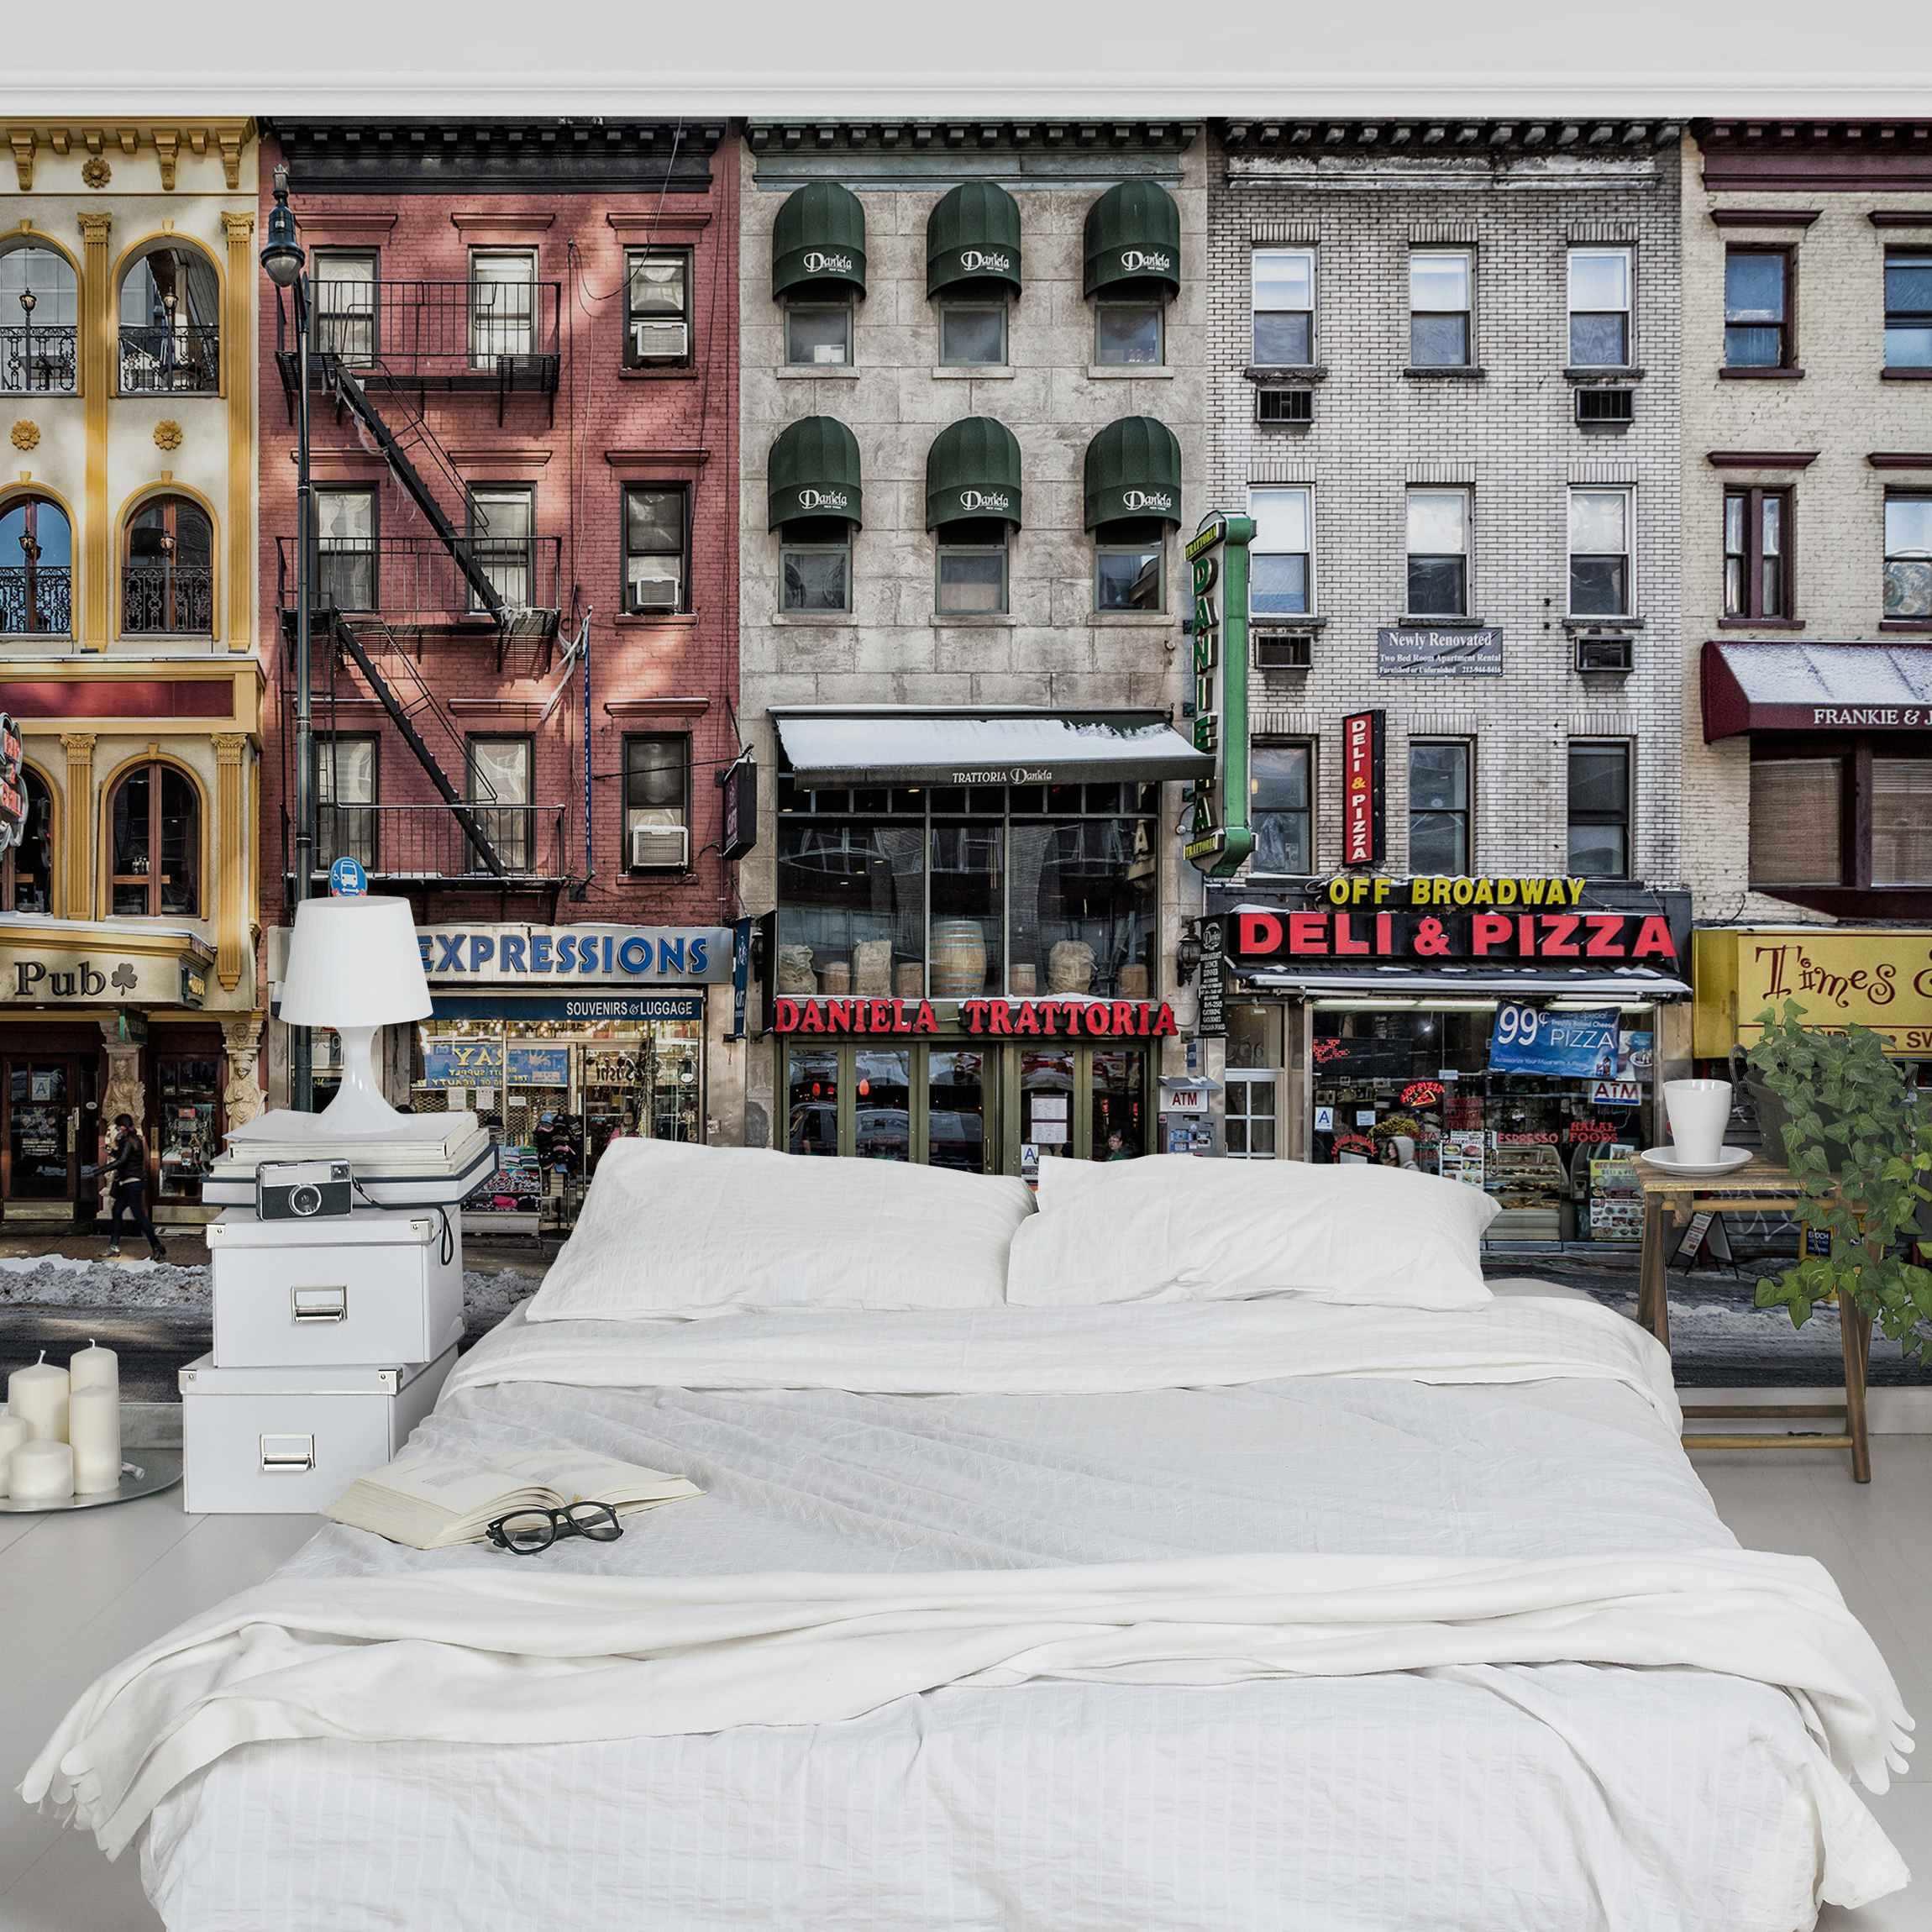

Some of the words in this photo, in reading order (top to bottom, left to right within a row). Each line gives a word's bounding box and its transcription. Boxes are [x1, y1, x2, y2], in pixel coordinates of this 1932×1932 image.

[804, 252, 852, 272] Daniela
[961, 250, 1010, 270] Daniela
[1121, 251, 1170, 271] Daniela
[799, 490, 847, 509] Daniela
[960, 491, 1009, 511] Daniela
[1123, 491, 1172, 511] Daniela
[1185, 524, 1218, 558] TRATTORIA
[1389, 632, 1426, 649] Newly
[1429, 632, 1492, 647] Renovated
[1380, 654, 1395, 662] Two
[1397, 654, 1411, 662] Bed
[1413, 654, 1435, 662] Room
[1436, 654, 1475, 663] Apartment
[1477, 654, 1501, 662] Rental
[1814, 709, 1899, 725] FRANKIE
[1903, 709, 1920, 725] &
[1352, 720, 1367, 772] DELI
[952, 772, 1007, 784] TRATTORIA
[1010, 768, 1053, 785] Daniela
[1351, 777, 1367, 790] &
[1352, 795, 1367, 860] PIZZA
[1184, 835, 1217, 860] TRATTORIA
[1329, 877, 1393, 905] OFF
[1411, 877, 1586, 906] BROADWAY
[1239, 913, 1393, 957] DELI
[1413, 916, 1451, 955] &
[1472, 913, 1677, 958] PIZZA
[13, 960, 107, 997] Pub
[1755, 944, 1897, 1008] Times
[566, 1001, 628, 1016] SOUVENIRS
[640, 1001, 693, 1016] LUGGAGE
[774, 997, 939, 1035] DANIELA
[964, 999, 1179, 1037] TRATTORIA
[1550, 1028, 1615, 1049] PIZZA
[1417, 1081, 1446, 1094] PIZZA
[1596, 1082, 1638, 1099] ATM
[1172, 1092, 1197, 1105] ATM
[1318, 1110, 1330, 1124] A
[1569, 1121, 1616, 1132] HALAL
[1497, 1132, 1559, 1144] ESPRESSO
[1569, 1131, 1619, 1143] FOODS
[1024, 1147, 1037, 1161] A
